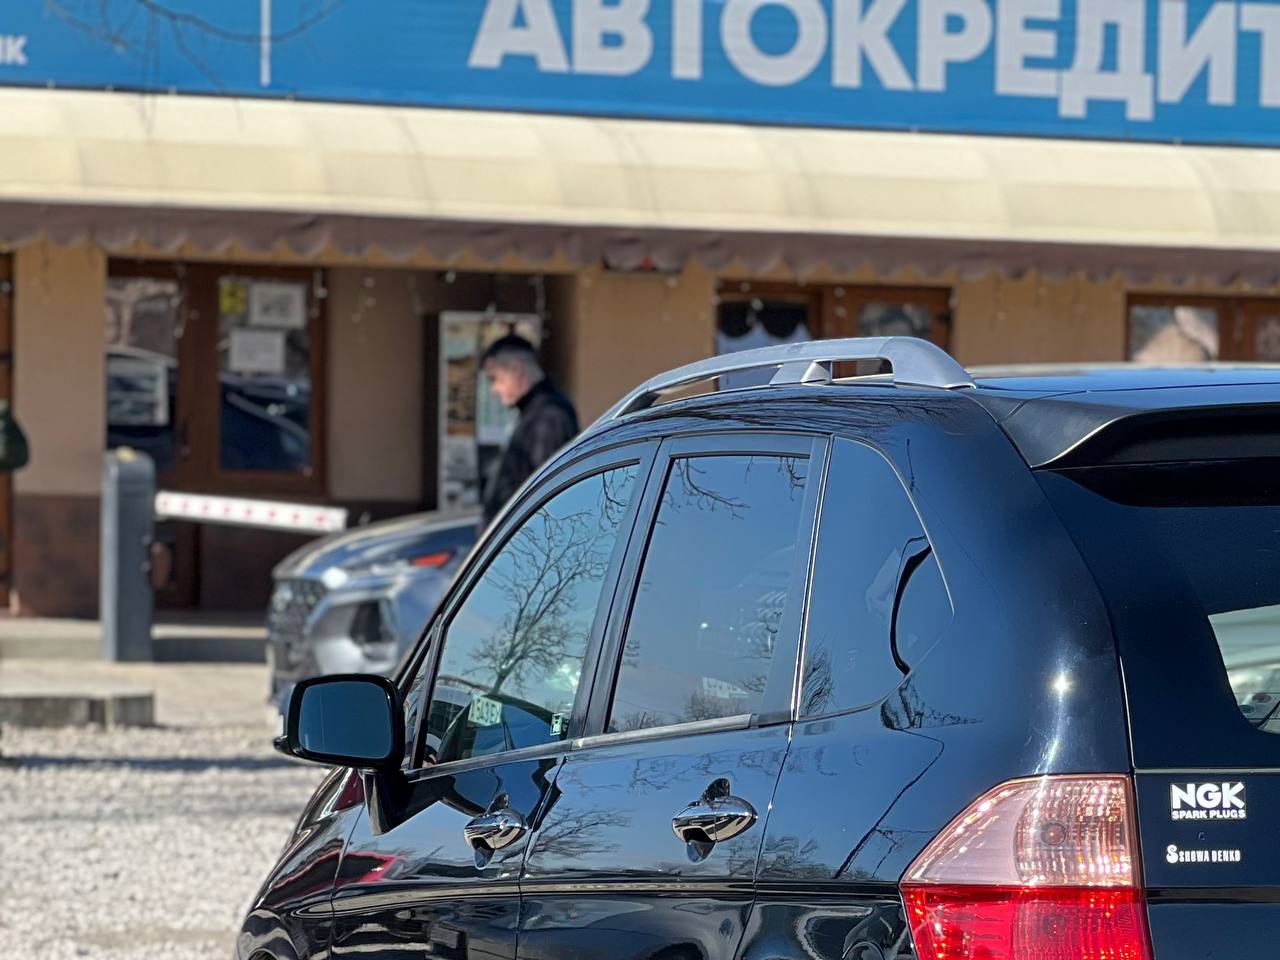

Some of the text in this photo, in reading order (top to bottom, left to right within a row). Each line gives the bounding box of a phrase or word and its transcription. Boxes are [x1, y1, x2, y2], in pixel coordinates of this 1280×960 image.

[1171, 782, 1245, 809] NGK
[1171, 809, 1246, 820] SPARK PLUGS
[1211, 849, 1241, 862] DENKO
